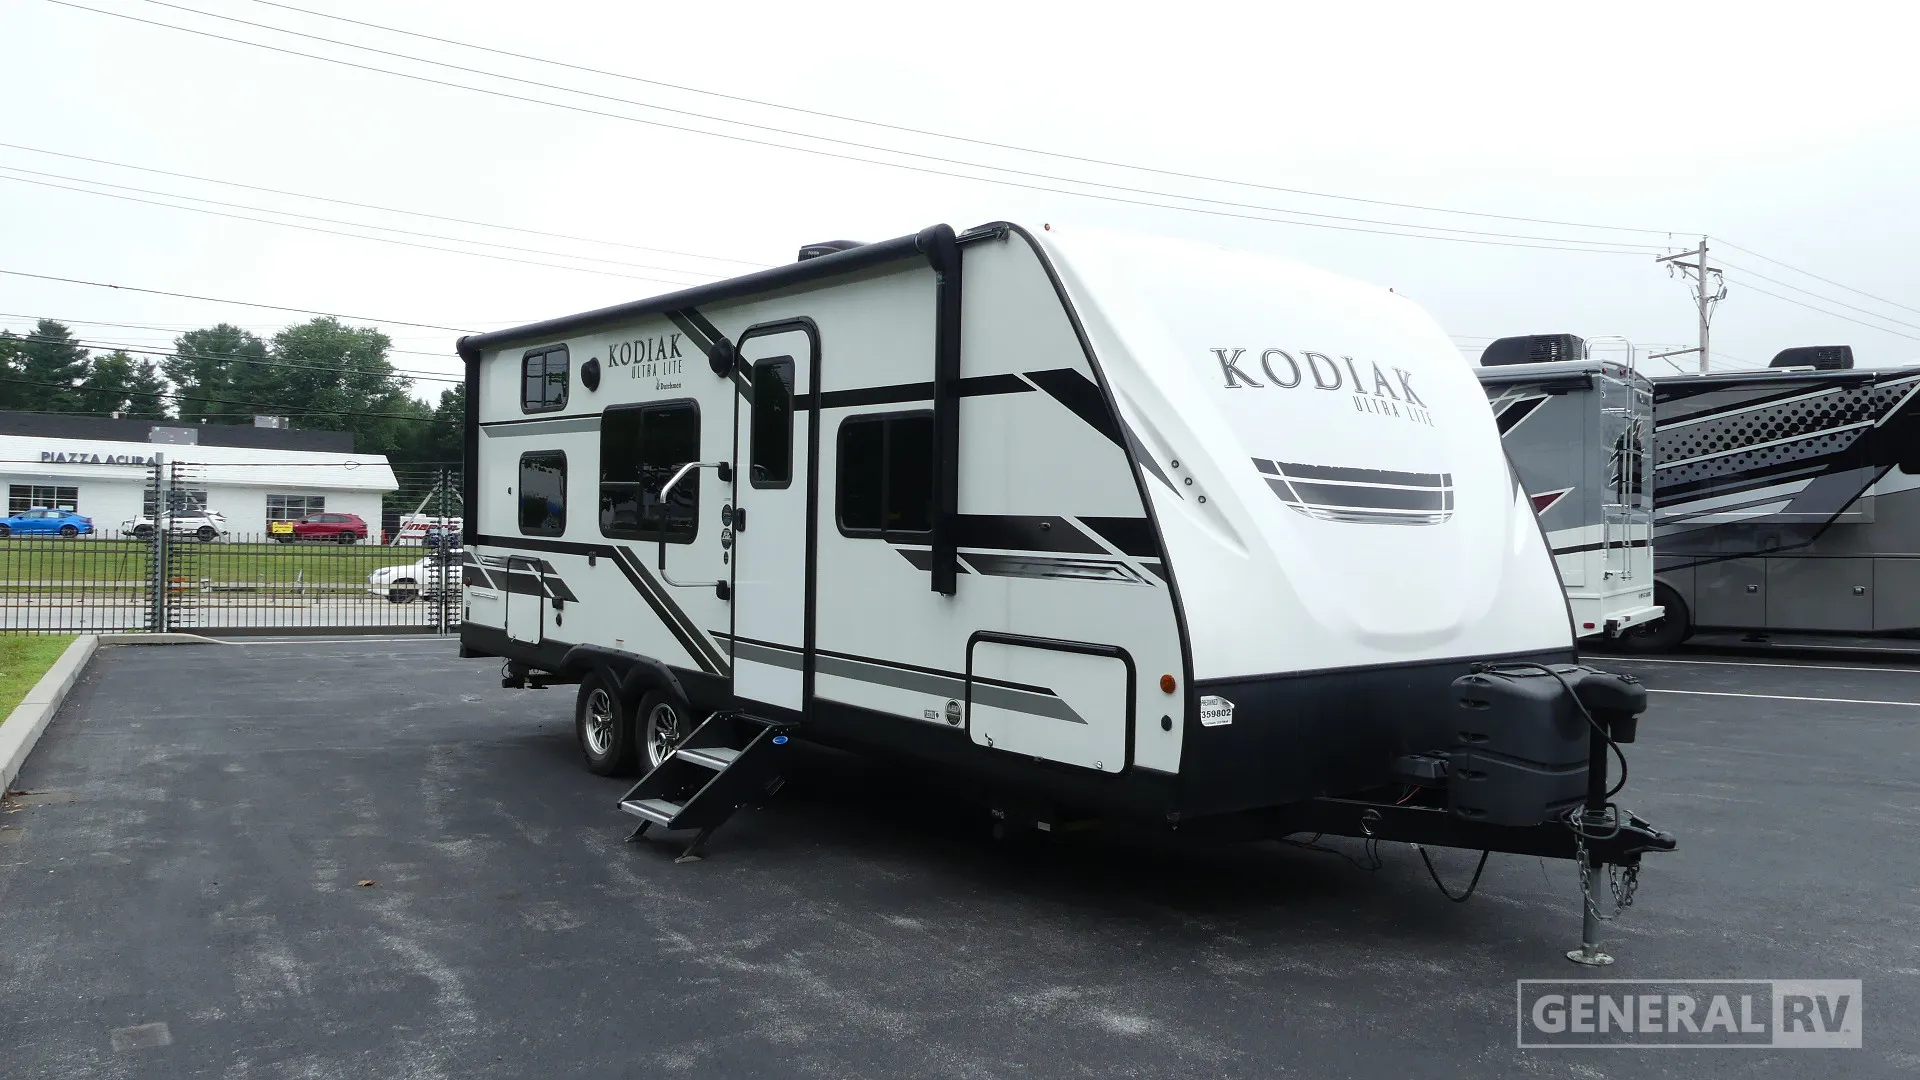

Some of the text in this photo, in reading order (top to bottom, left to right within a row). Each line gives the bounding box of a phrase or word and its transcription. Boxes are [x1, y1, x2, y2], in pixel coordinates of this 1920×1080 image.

[608, 333, 682, 368] KODIAK
[631, 360, 682, 380] ULTRA LITE
[1209, 347, 1428, 409] KODIAK
[1352, 395, 1435, 428] ULTRA LITE
[41, 451, 156, 466] PIAZZA ACURA
[1201, 709, 1232, 718] 359802
